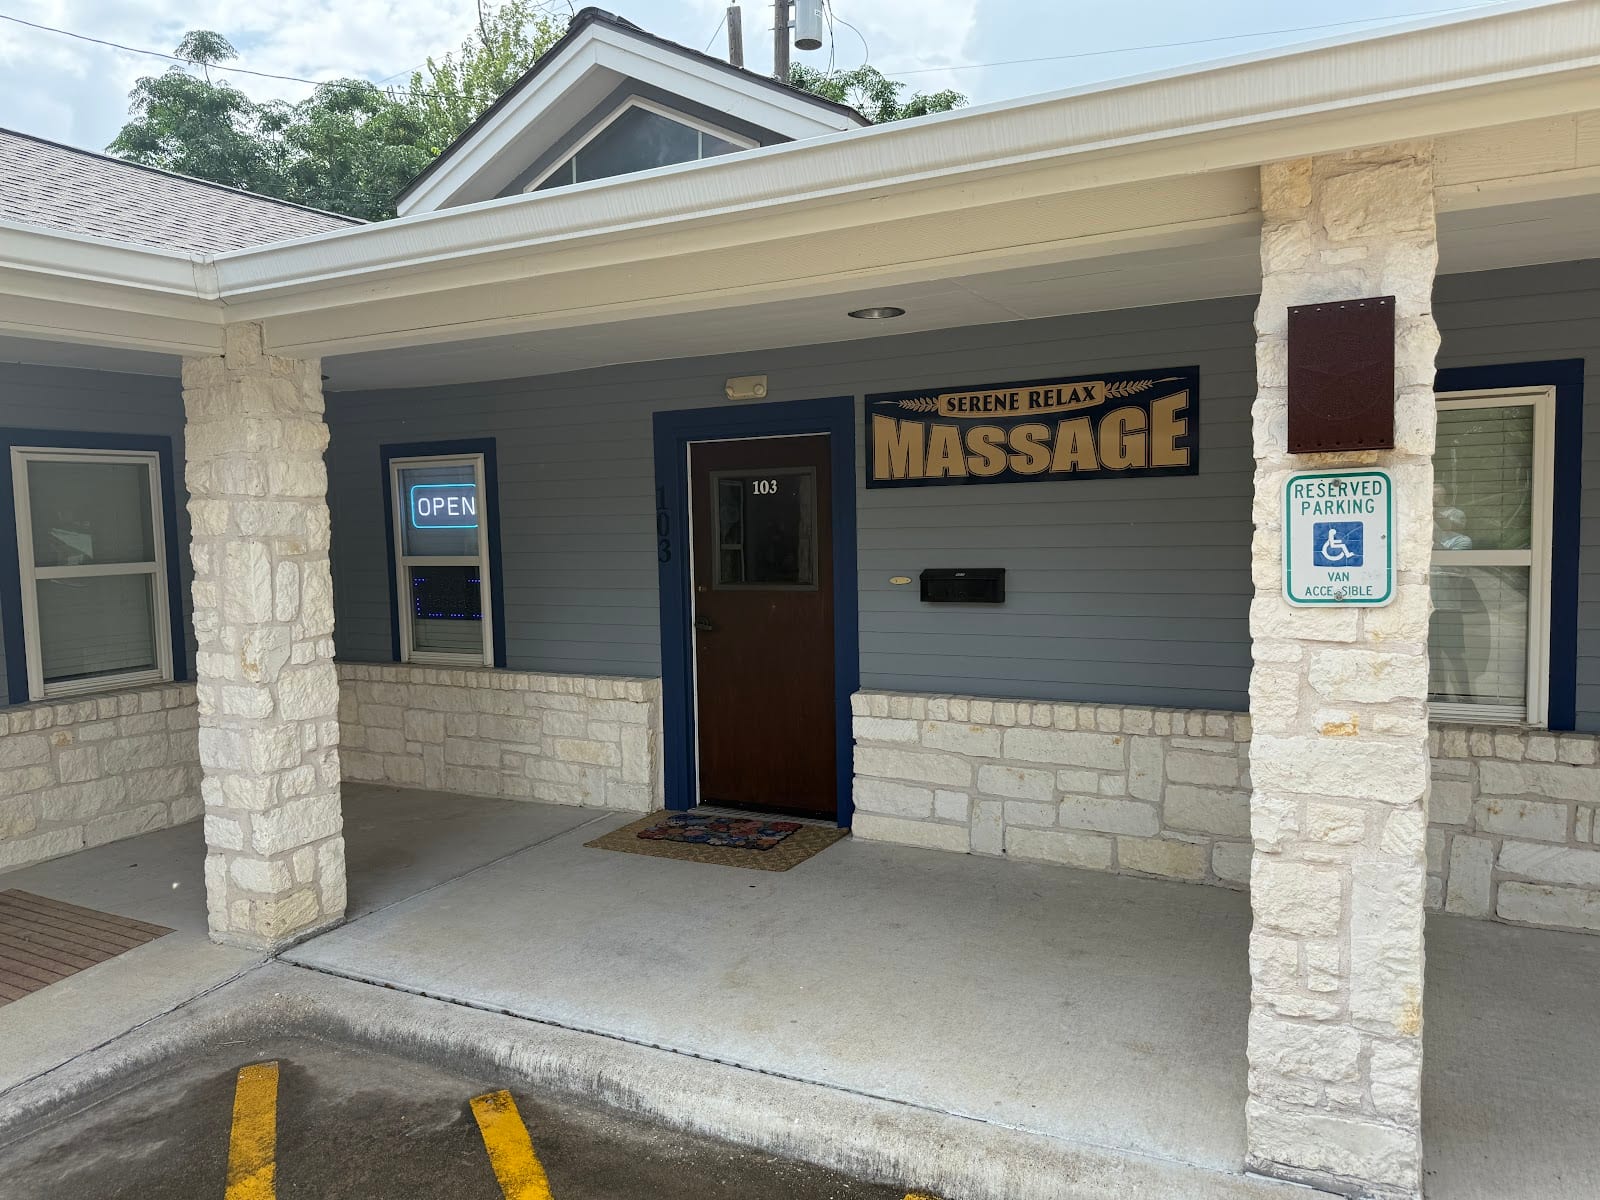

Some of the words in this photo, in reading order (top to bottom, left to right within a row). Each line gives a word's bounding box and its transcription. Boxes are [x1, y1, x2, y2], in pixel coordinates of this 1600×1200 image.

[946, 391, 1020, 412] SERENE
[1028, 385, 1096, 409] RELAX
[872, 389, 1190, 481] MASSAGE
[752, 480, 778, 495] 103
[1294, 480, 1382, 499] RESERVED
[418, 496, 476, 516] OPEN
[1301, 498, 1375, 516] PARKING
[655, 484, 671, 563] 103
[1327, 572, 1350, 582] VAN
[1304, 585, 1373, 597] ACCESIBLE
